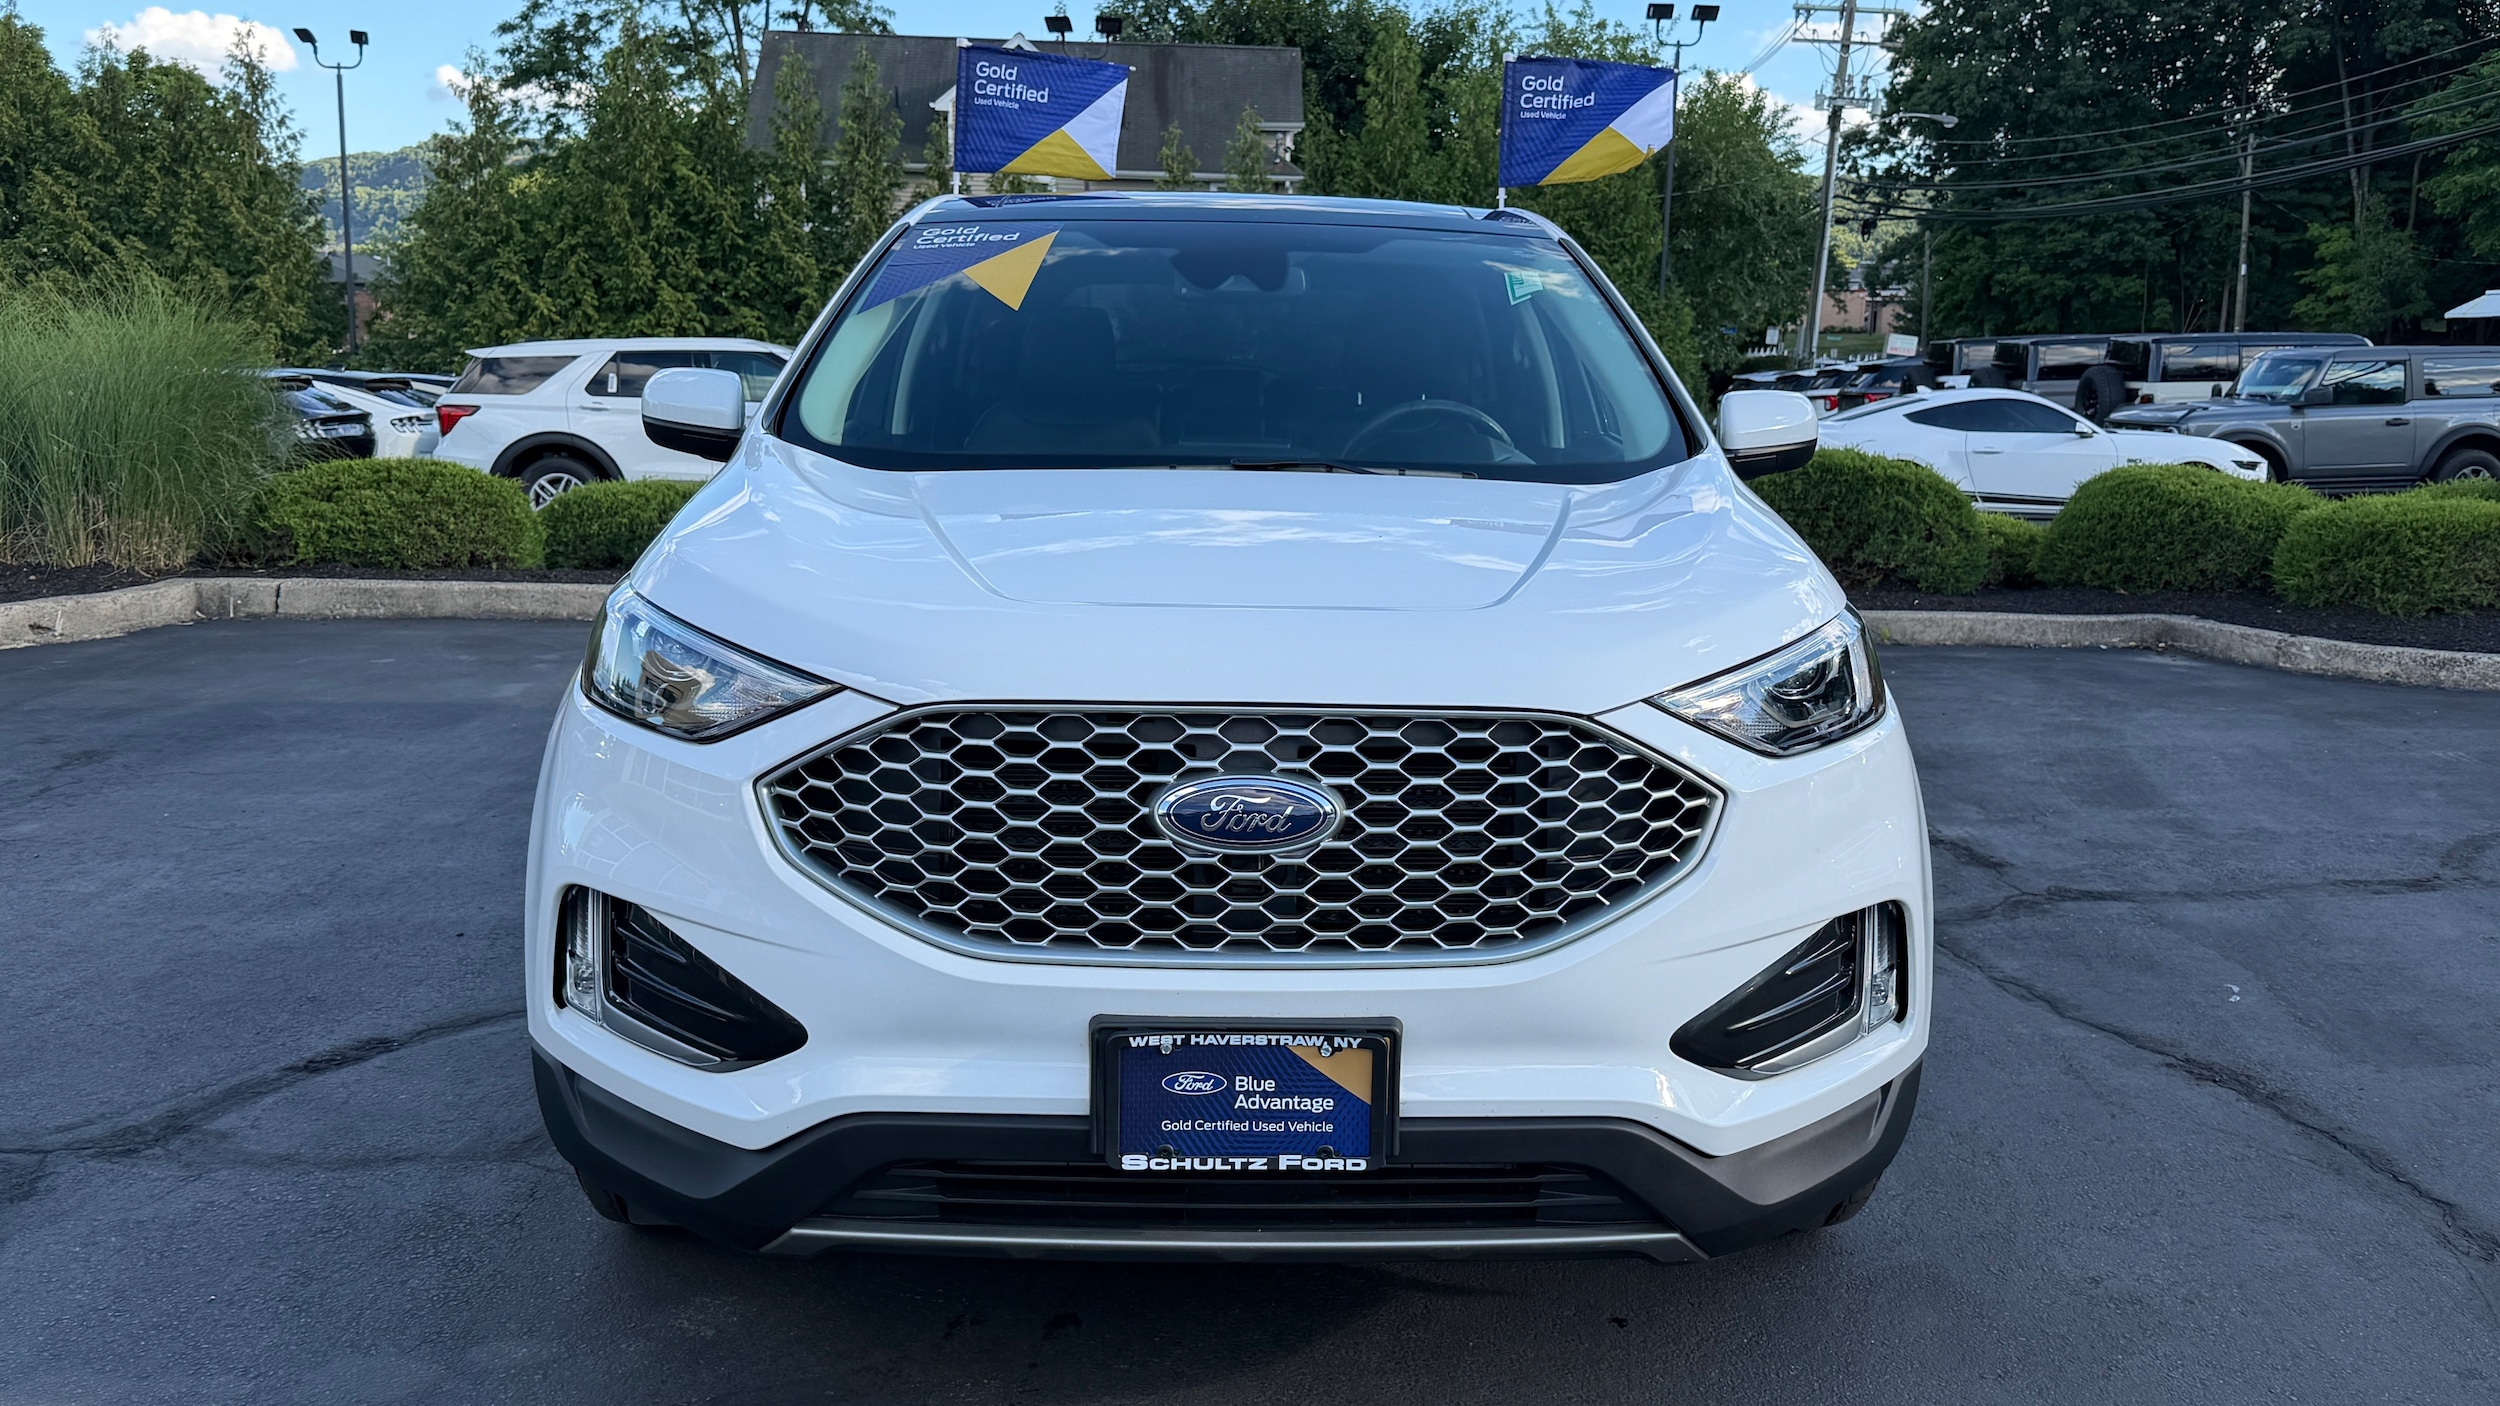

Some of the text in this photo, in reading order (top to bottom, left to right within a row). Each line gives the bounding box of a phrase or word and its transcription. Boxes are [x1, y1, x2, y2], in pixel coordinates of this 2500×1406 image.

[976, 61, 1018, 81] Gold
[974, 79, 1049, 103] Certified
[1521, 75, 1565, 92] Gold
[974, 97, 1020, 109] Used Vehicle
[1520, 91, 1595, 110] Certified
[1520, 111, 1567, 120] Used Vehicle
[916, 232, 1020, 244] Certified
[922, 226, 980, 236] Gold
[1200, 794, 1293, 834] Ford
[1128, 1034, 1186, 1048] WEST
[1334, 1036, 1363, 1049] NY
[1174, 1074, 1214, 1091] Ford
[1235, 1076, 1276, 1092] Blue
[1234, 1094, 1334, 1113] Advantage
[1161, 1120, 1334, 1133] Gold Certified Used Vehicle
[1121, 1154, 1368, 1171] SCHULTZ FORD
